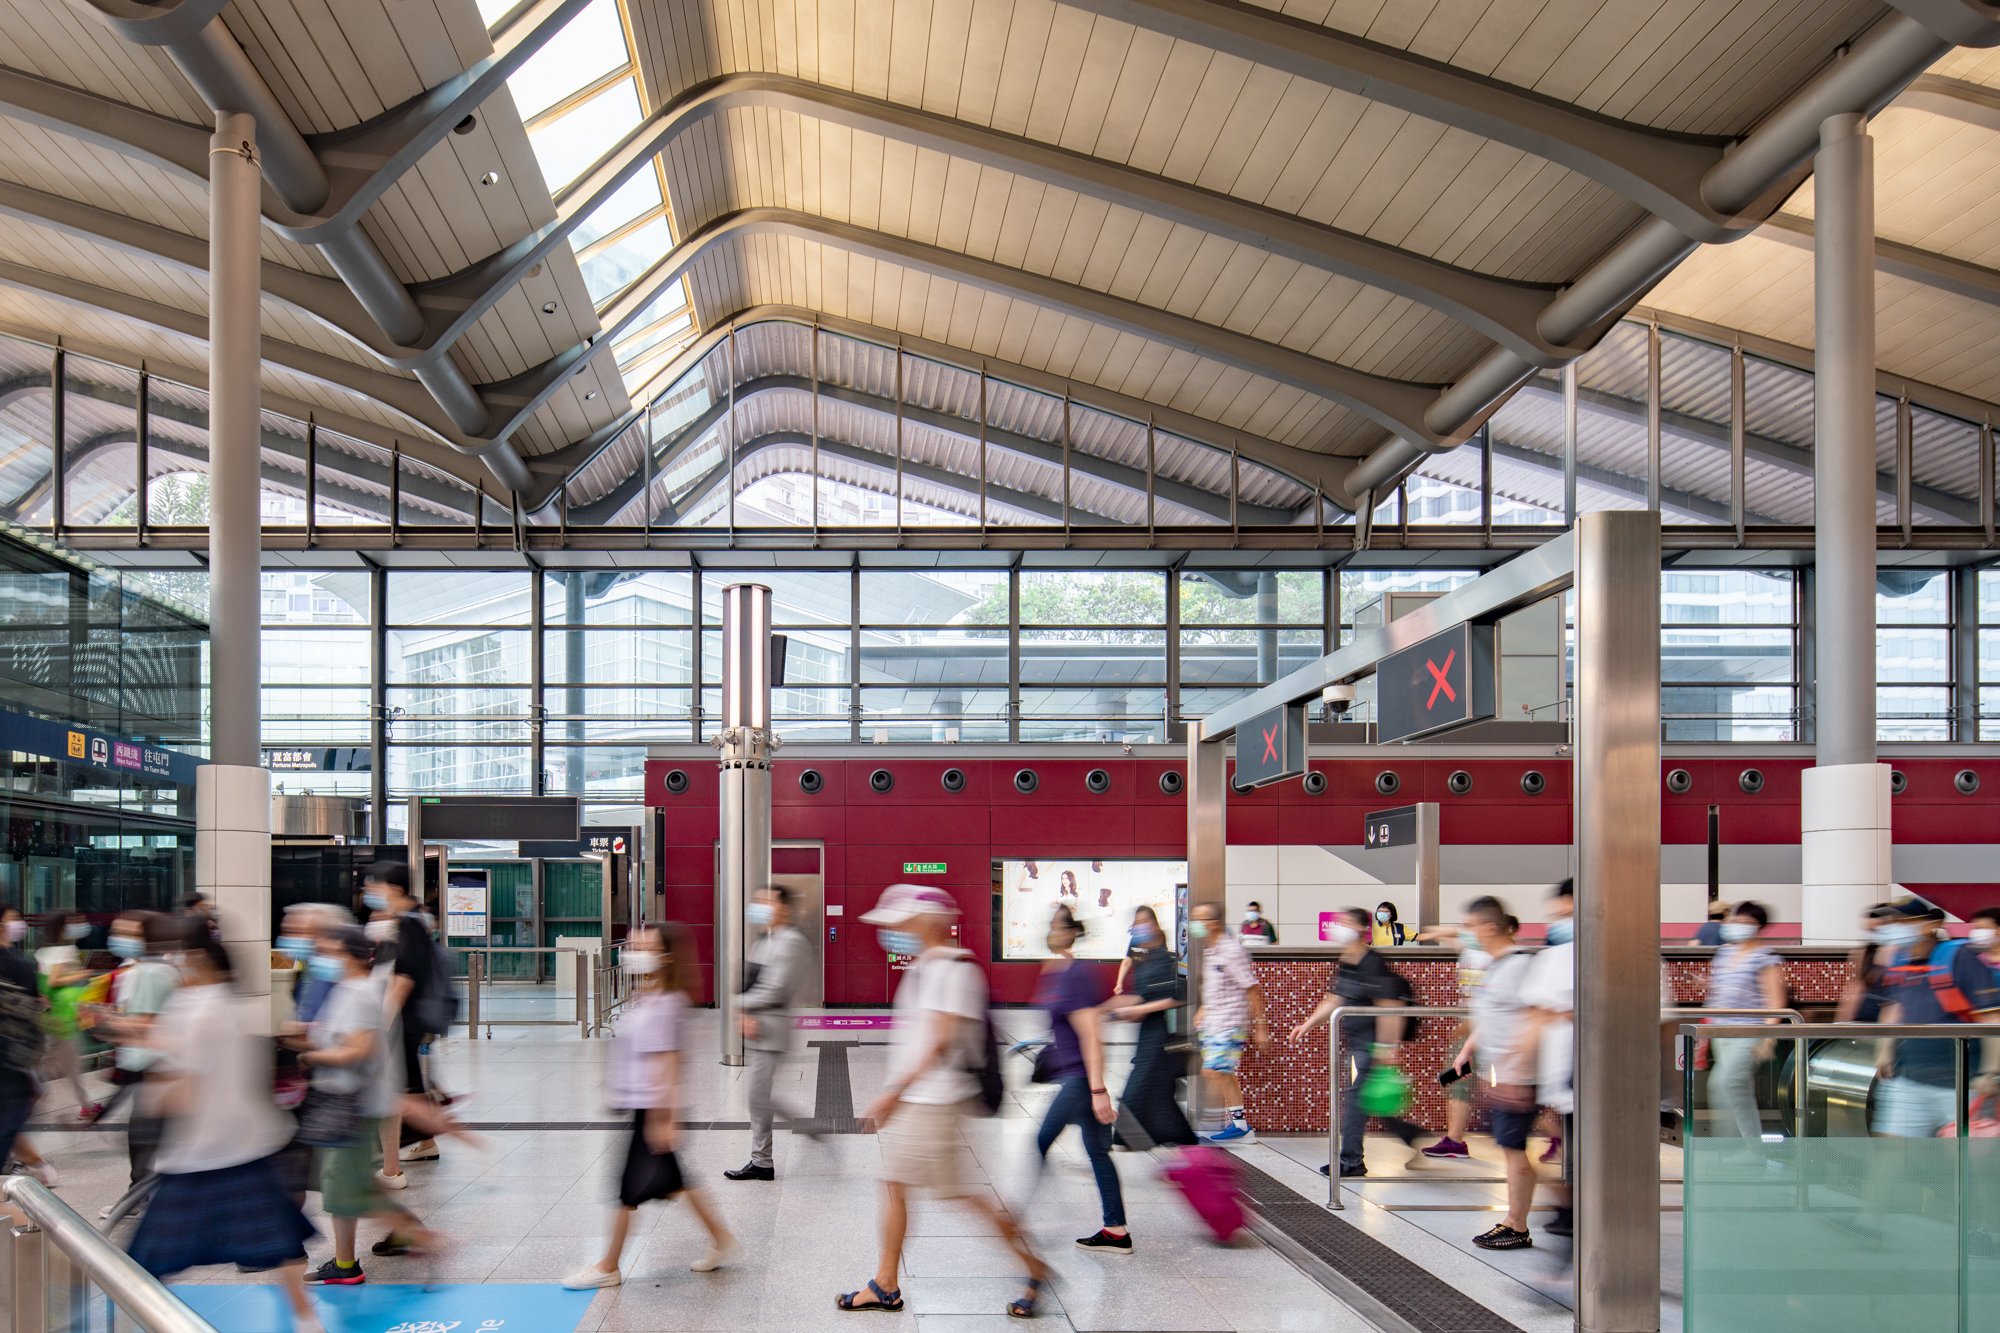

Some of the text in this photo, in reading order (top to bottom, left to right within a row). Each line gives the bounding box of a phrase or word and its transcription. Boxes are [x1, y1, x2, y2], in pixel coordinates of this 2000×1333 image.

[144, 749, 169, 766] 往屯門
[272, 751, 312, 762] 置富都會
[160, 768, 170, 776] Mun
[589, 837, 609, 848] 車票
